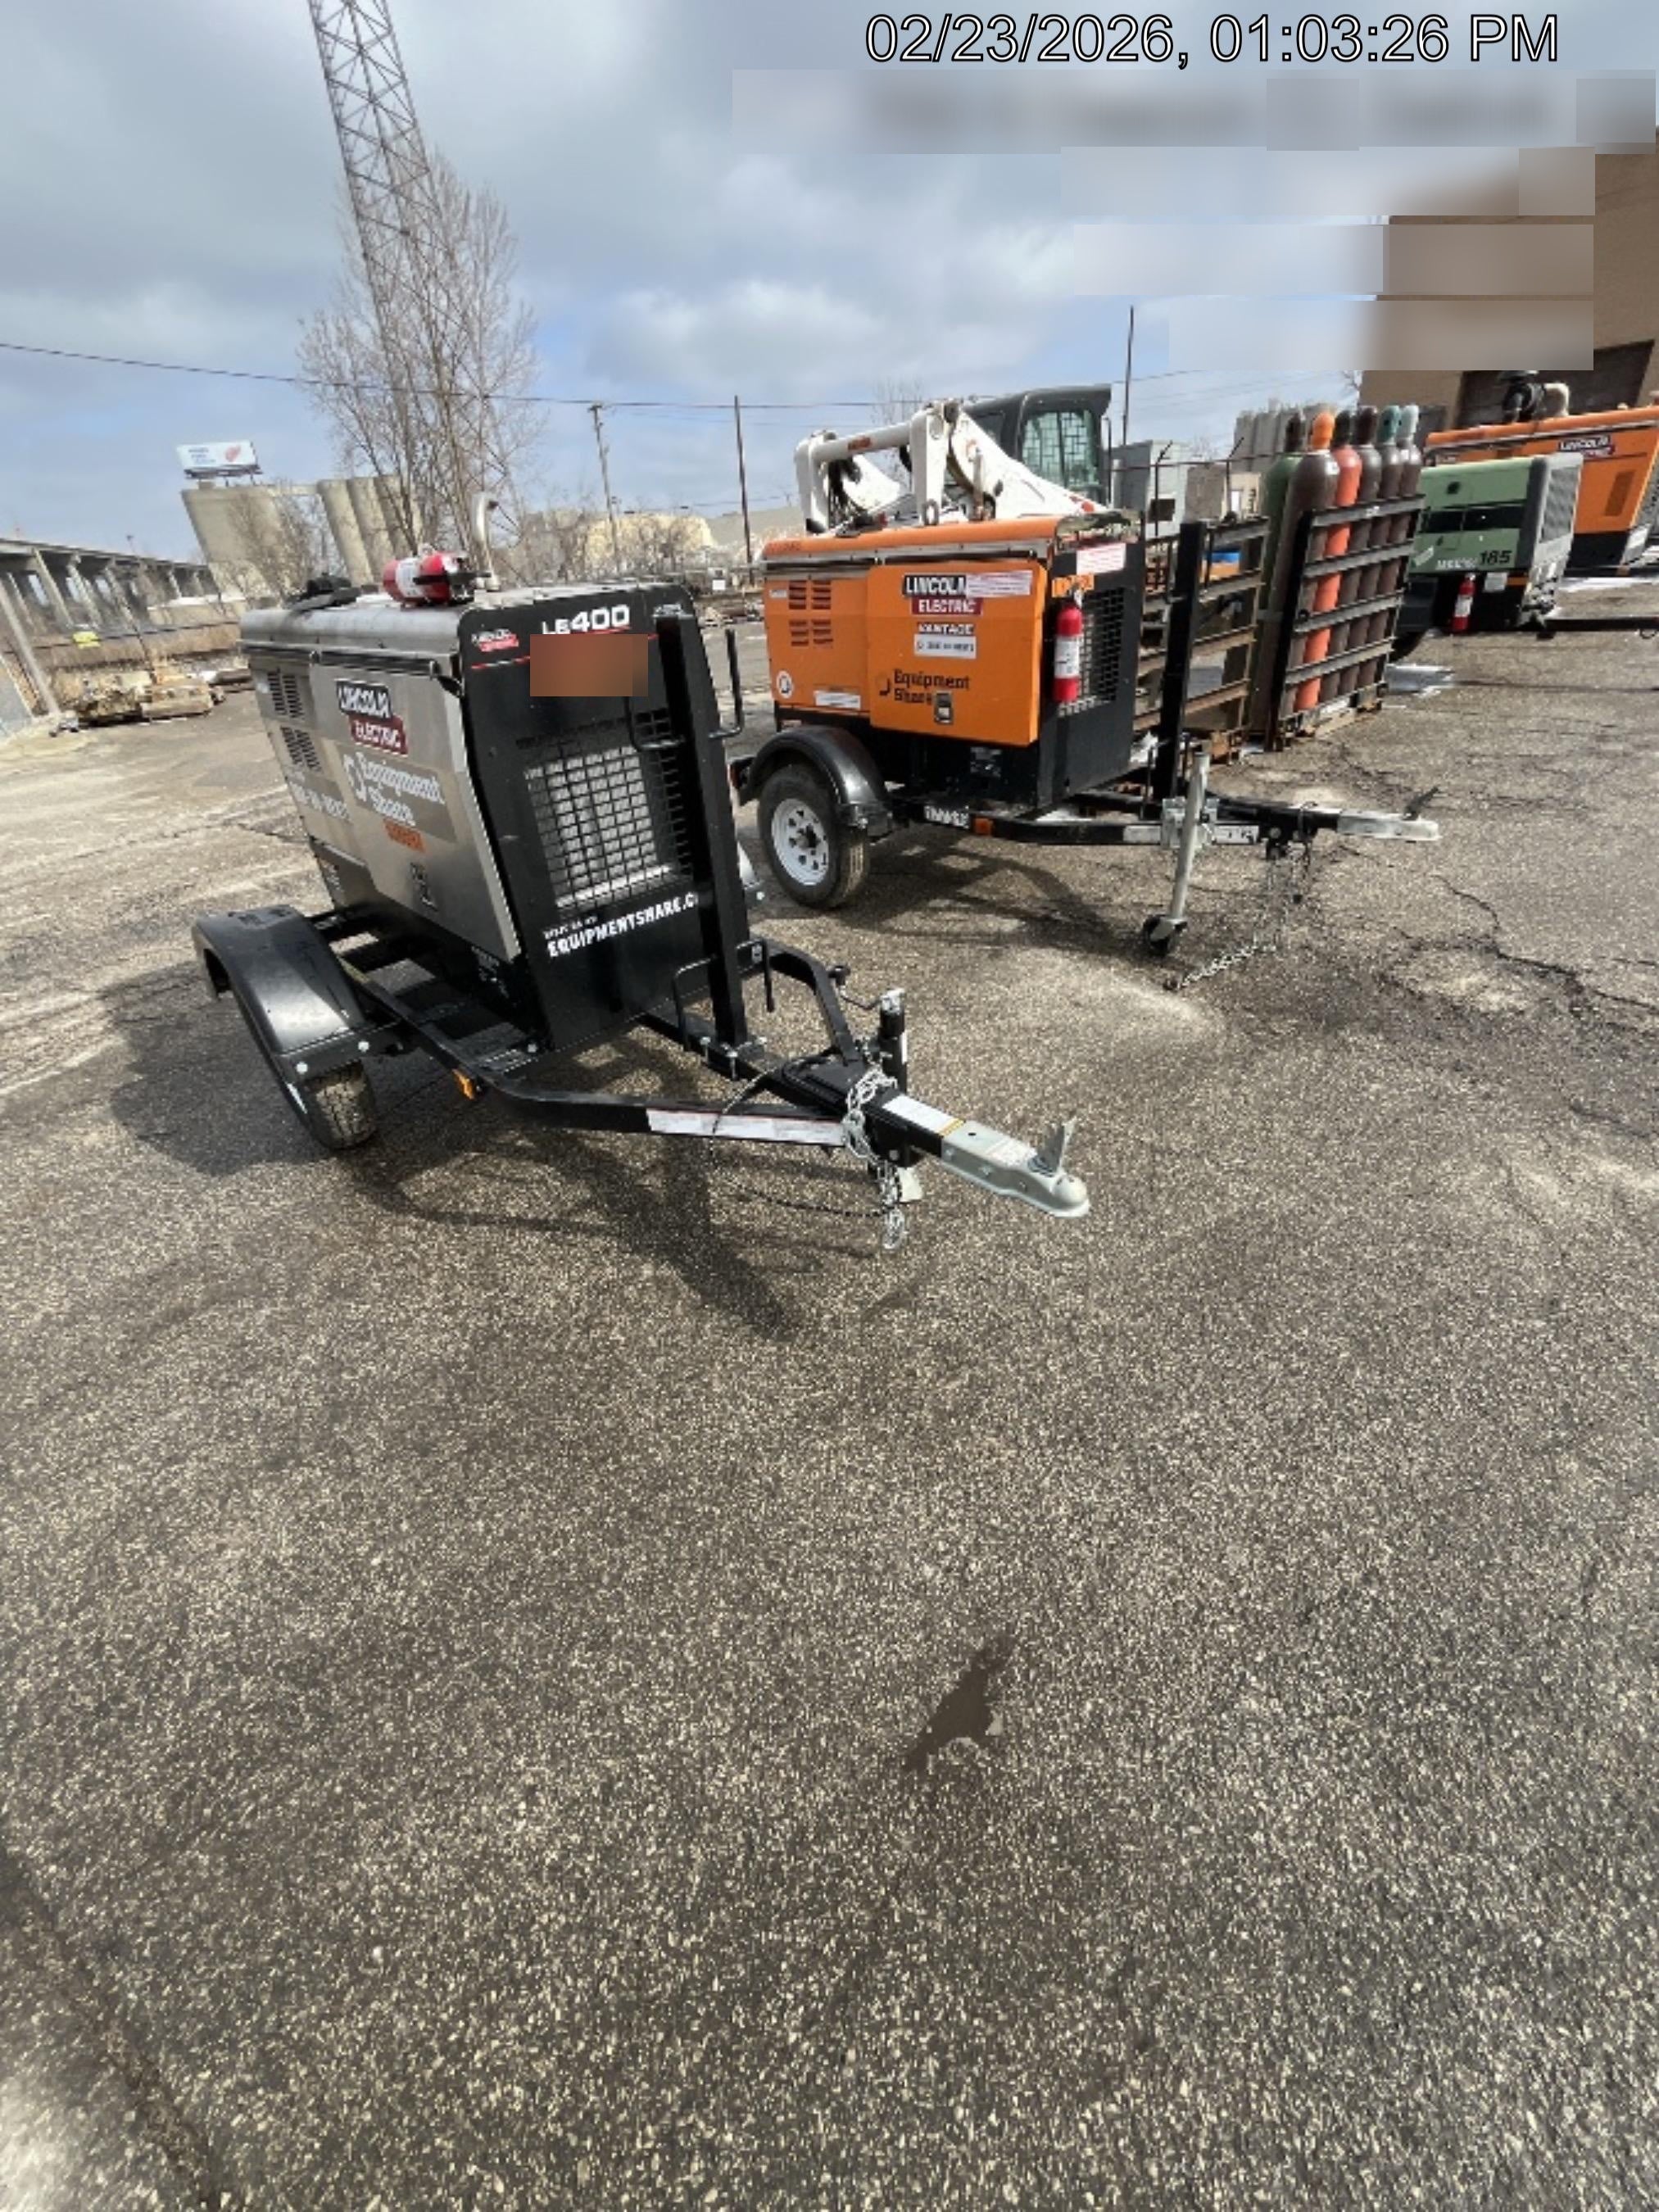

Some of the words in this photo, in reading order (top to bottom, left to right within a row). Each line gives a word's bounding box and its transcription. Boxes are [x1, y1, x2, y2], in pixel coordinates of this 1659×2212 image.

[1479, 550, 1512, 565] 185
[918, 599, 977, 614] ELECTRIC
[894, 669, 970, 690] Equipment
[546, 891, 699, 958] EQUIPMENTSHARE.C
